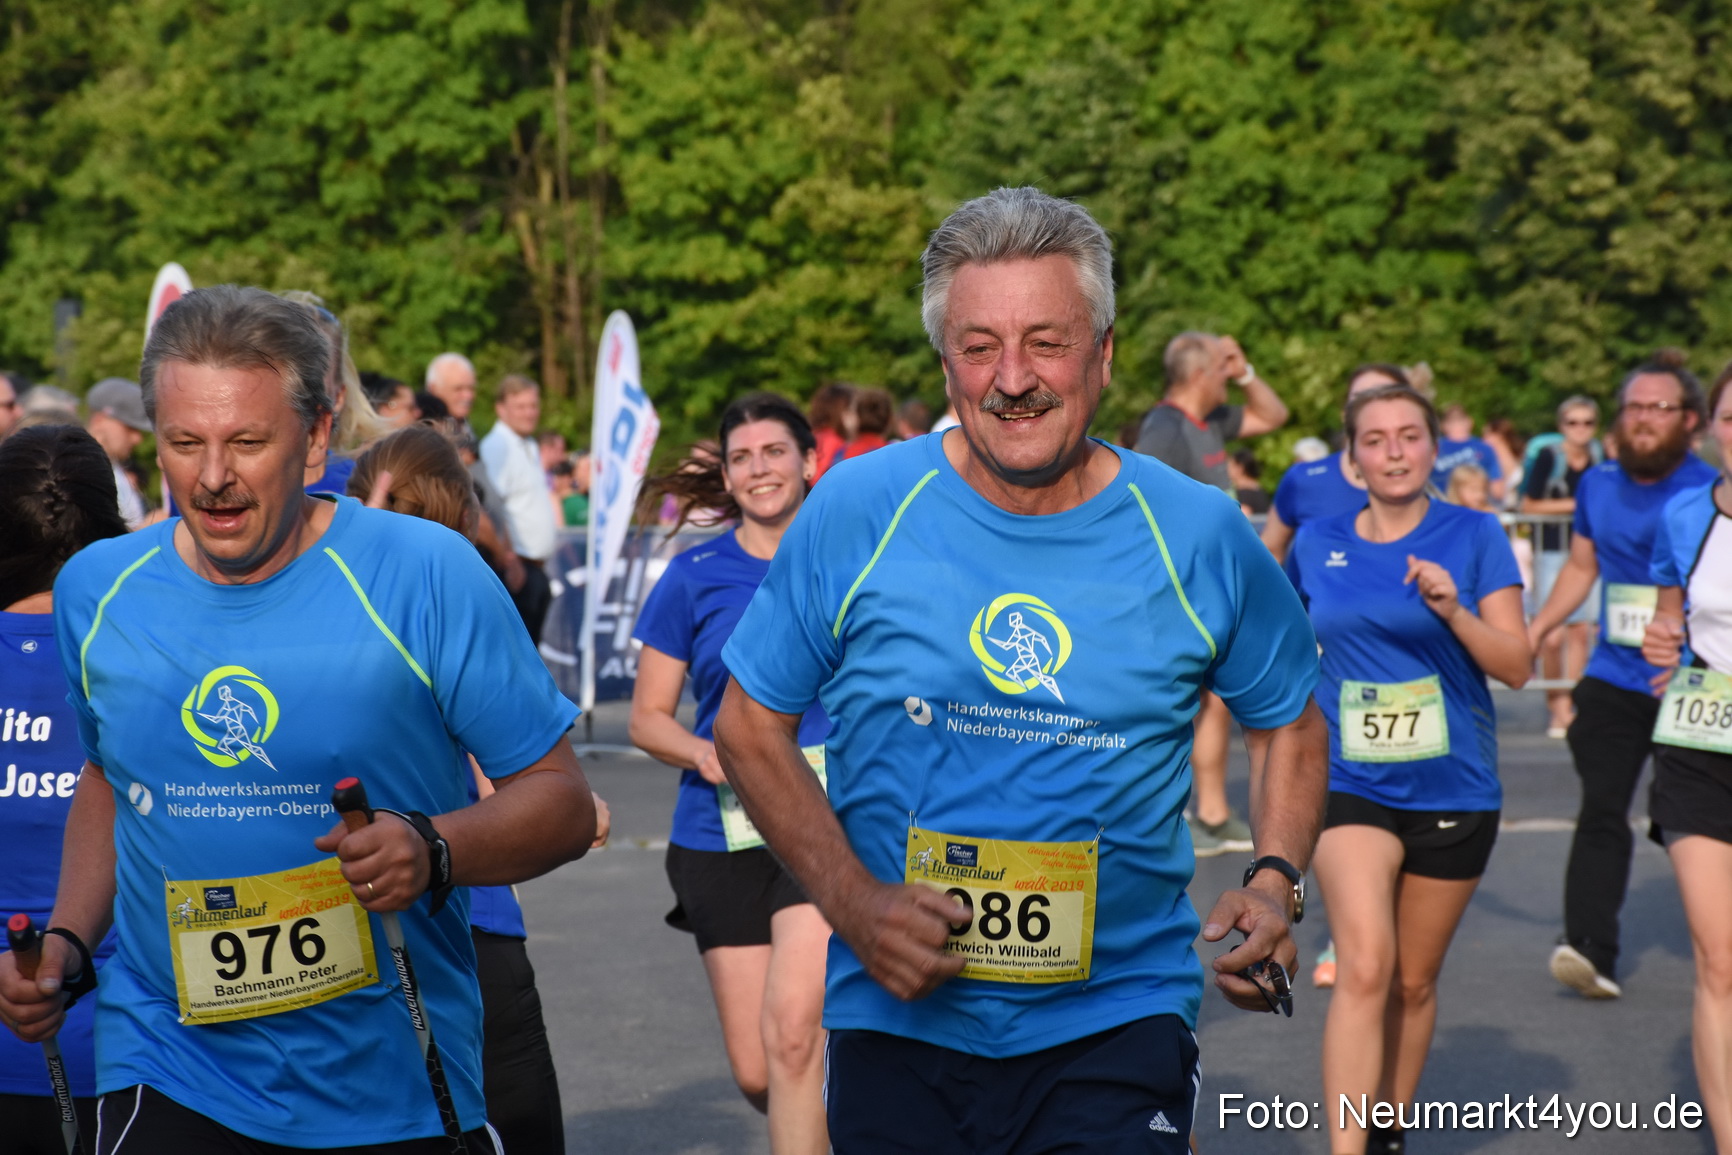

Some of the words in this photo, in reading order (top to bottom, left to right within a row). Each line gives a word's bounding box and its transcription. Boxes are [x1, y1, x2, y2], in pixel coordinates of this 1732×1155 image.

[0, 707, 52, 742] ita
[947, 701, 1100, 729] Handwerkskammer
[1363, 710, 1420, 740] 577
[1674, 694, 1732, 730] 1038
[947, 718, 1127, 751] Niederbayern-Oberpfalz
[164, 781, 321, 797] Handwerkskammer
[167, 800, 335, 822] Niederbayern-Oberp
[933, 860, 1007, 881] firmenlauf
[1014, 876, 1048, 892] walk
[1051, 880, 1084, 892] 2019
[194, 902, 268, 922] firmenlauf
[279, 900, 313, 920] walk
[315, 893, 350, 912] 2019
[210, 917, 326, 981] 976
[942, 940, 994, 955] artwich
[998, 944, 1061, 958] Willibald
[986, 957, 1079, 968] Niederbayern-Oberpfalz
[190, 994, 268, 1009] Handwerkskammer
[269, 967, 365, 999] Niederbayern-Oberpfalz
[214, 976, 295, 998] Bachmann
[298, 962, 338, 983] Peter
[1148, 1123, 1179, 1135] adidas
